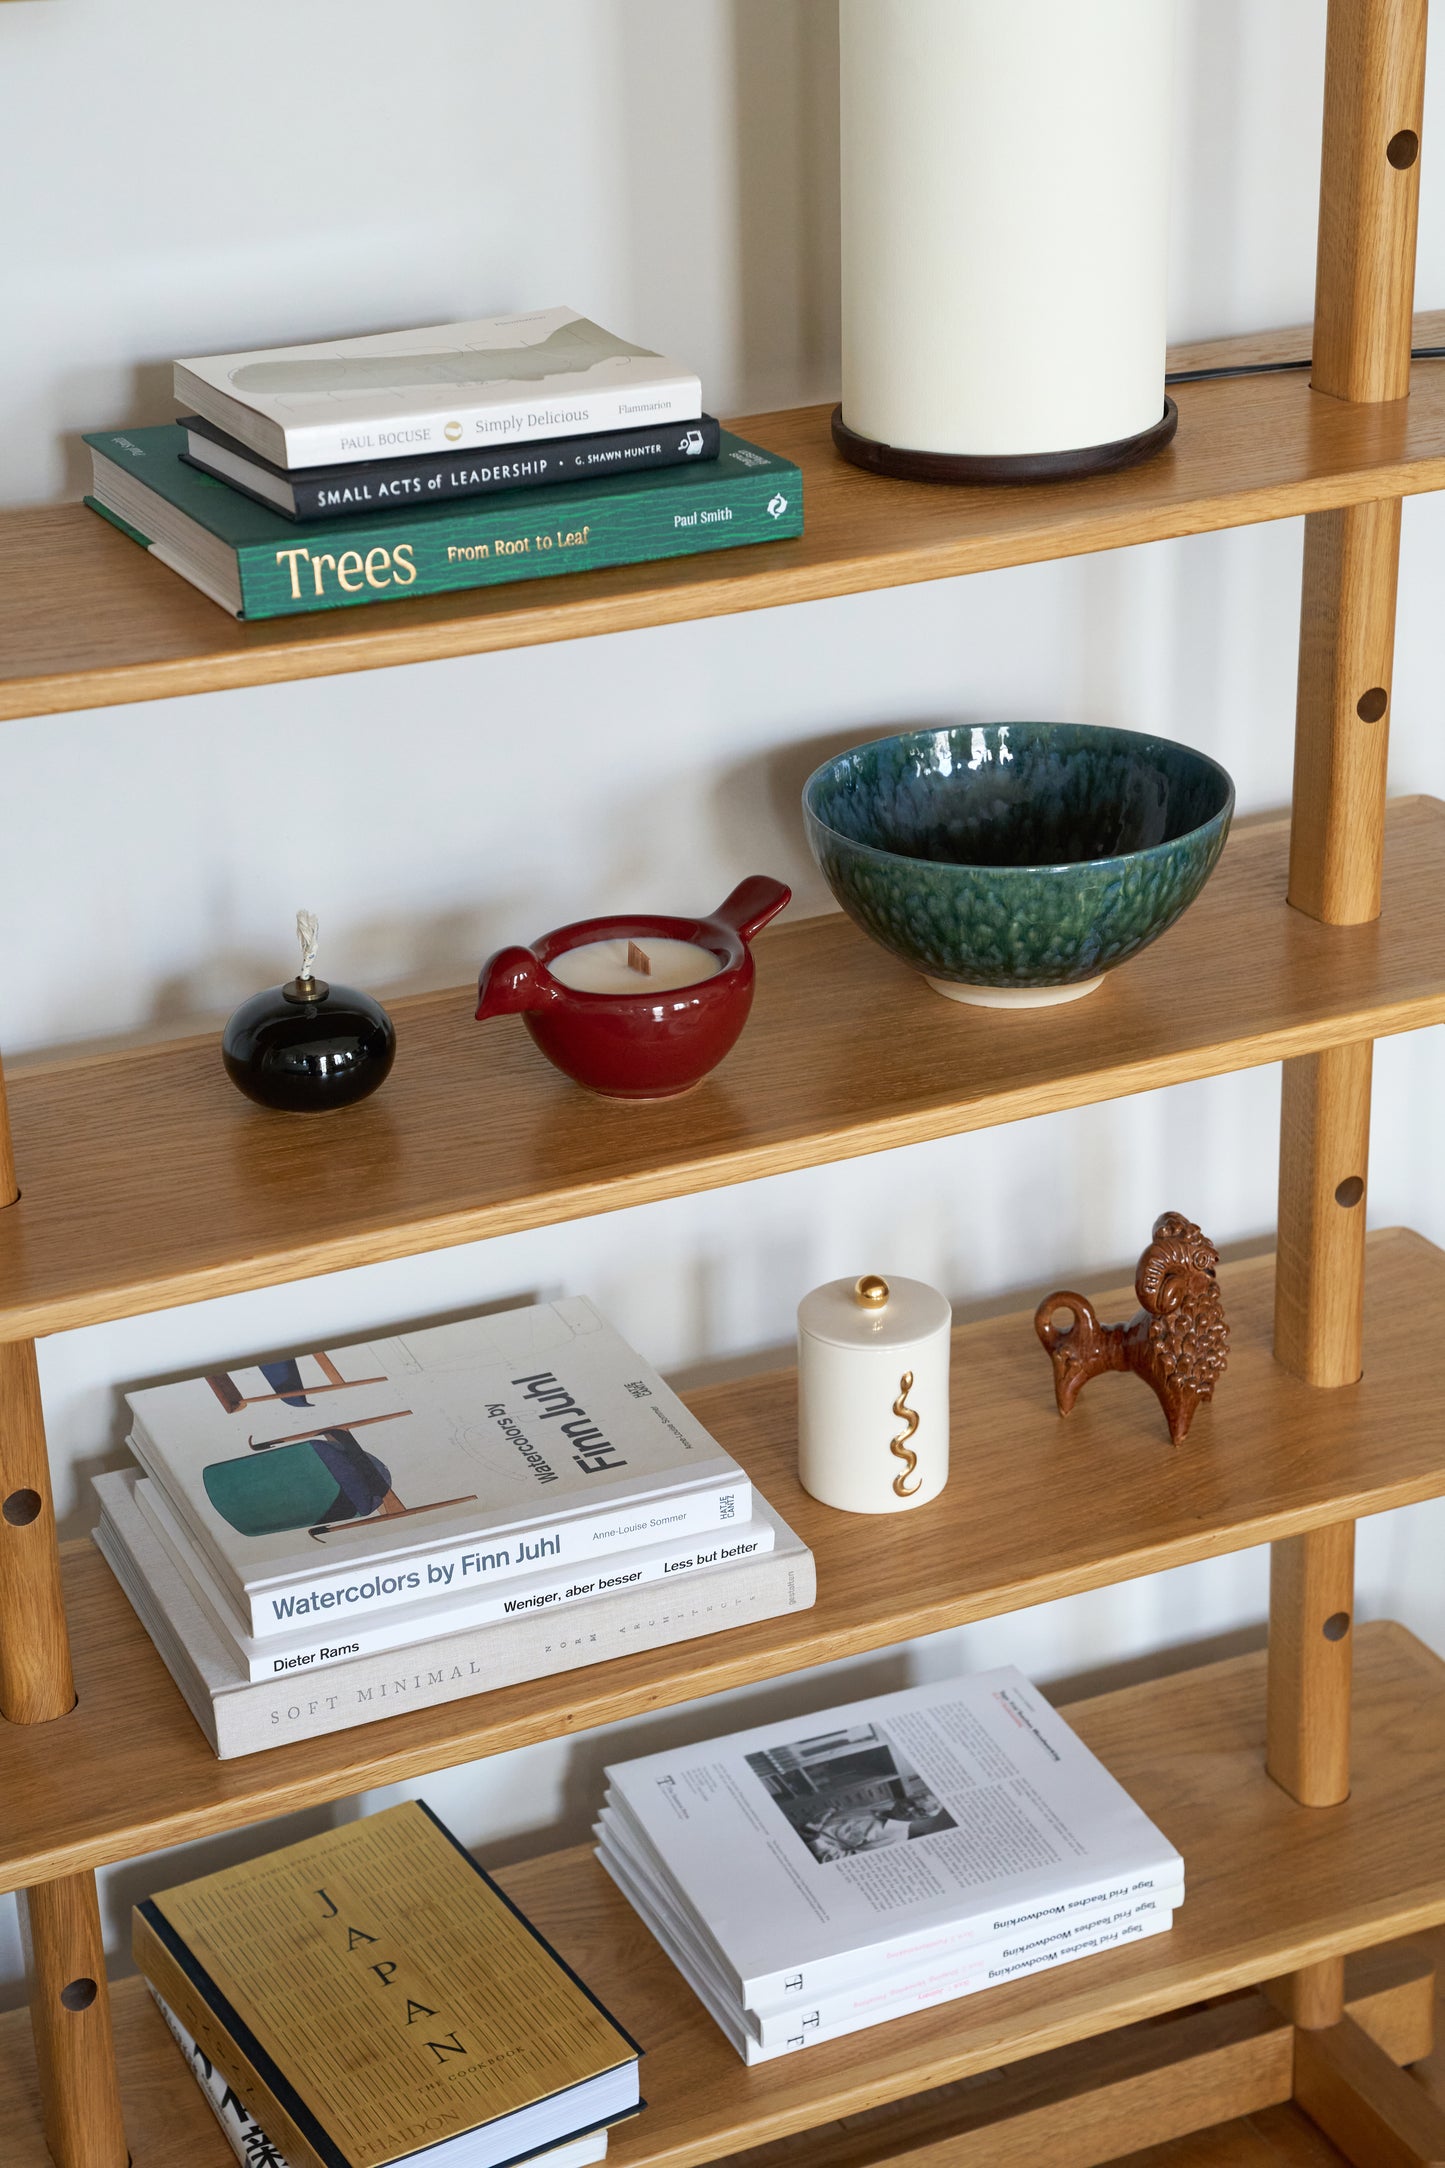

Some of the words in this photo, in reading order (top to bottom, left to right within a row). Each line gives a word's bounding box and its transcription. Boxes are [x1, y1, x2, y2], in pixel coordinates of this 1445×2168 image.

[476, 414, 523, 433] Simply
[527, 409, 589, 427] Delicious
[618, 400, 672, 414] Flammarion
[340, 436, 375, 450] PAUL
[379, 428, 431, 445] BOCUSE
[575, 456, 585, 465] G.
[588, 450, 622, 465] SHAWN
[624, 444, 662, 459] HUNTER
[318, 485, 372, 507] SMALL
[378, 478, 421, 497] ACTS
[427, 474, 443, 489] of
[451, 459, 548, 486] LEADERSHIP
[674, 511, 698, 528] Paul
[700, 507, 733, 524] Smith
[447, 544, 490, 564] From
[494, 537, 531, 557] Root
[535, 534, 553, 551] to
[557, 526, 591, 547] Leaf
[276, 544, 417, 599] Trees
[511, 1371, 586, 1420] Juhl
[484, 1403, 506, 1419] by
[497, 1417, 559, 1484] Watercolors
[560, 1417, 629, 1474] Finn
[719, 1496, 728, 1520] HATJE
[727, 1494, 735, 1518] CANTZ
[592, 1521, 648, 1541] Anne-Louise
[649, 1511, 688, 1528] Sommer
[664, 1558, 694, 1573] Less
[697, 1551, 718, 1566] but
[721, 1542, 759, 1560] better
[272, 1571, 420, 1620] Watercolors
[427, 1563, 455, 1585] by
[461, 1549, 510, 1577] Finn
[515, 1534, 561, 1564] Juhl
[787, 1570, 797, 1606] gestalten
[503, 1590, 562, 1614] Weniger,
[565, 1582, 596, 1598] aber
[598, 1570, 643, 1590] besser
[545, 1633, 597, 1653] NORM
[619, 1595, 756, 1633] ARCHITECTS
[273, 1654, 316, 1673] Dieter
[319, 1642, 360, 1661] Rams
[270, 1695, 339, 1725] SOFT
[356, 1661, 482, 1703] MINIMAL
[1109, 1887, 1129, 1899] Frid
[1131, 1879, 1154, 1892] Tage
[1068, 1893, 1107, 1909] Teaches
[1135, 1901, 1157, 1914] Tage
[993, 1904, 1066, 1930] Woodworking
[1074, 1916, 1112, 1934] Teaches
[1113, 1909, 1132, 1922] Frid
[1002, 1929, 1072, 1958] Woodworking
[1100, 1932, 1119, 1945] Frid
[1121, 1924, 1144, 1937] Tage
[1060, 1939, 1098, 1955] Teaches
[313, 1887, 468, 2065] JAPAN
[988, 1951, 1058, 1979] Woodworking
[416, 2080, 444, 2095] THE
[448, 2045, 526, 2082] COOKBOOK
[353, 2108, 461, 2159] PHAIDON
